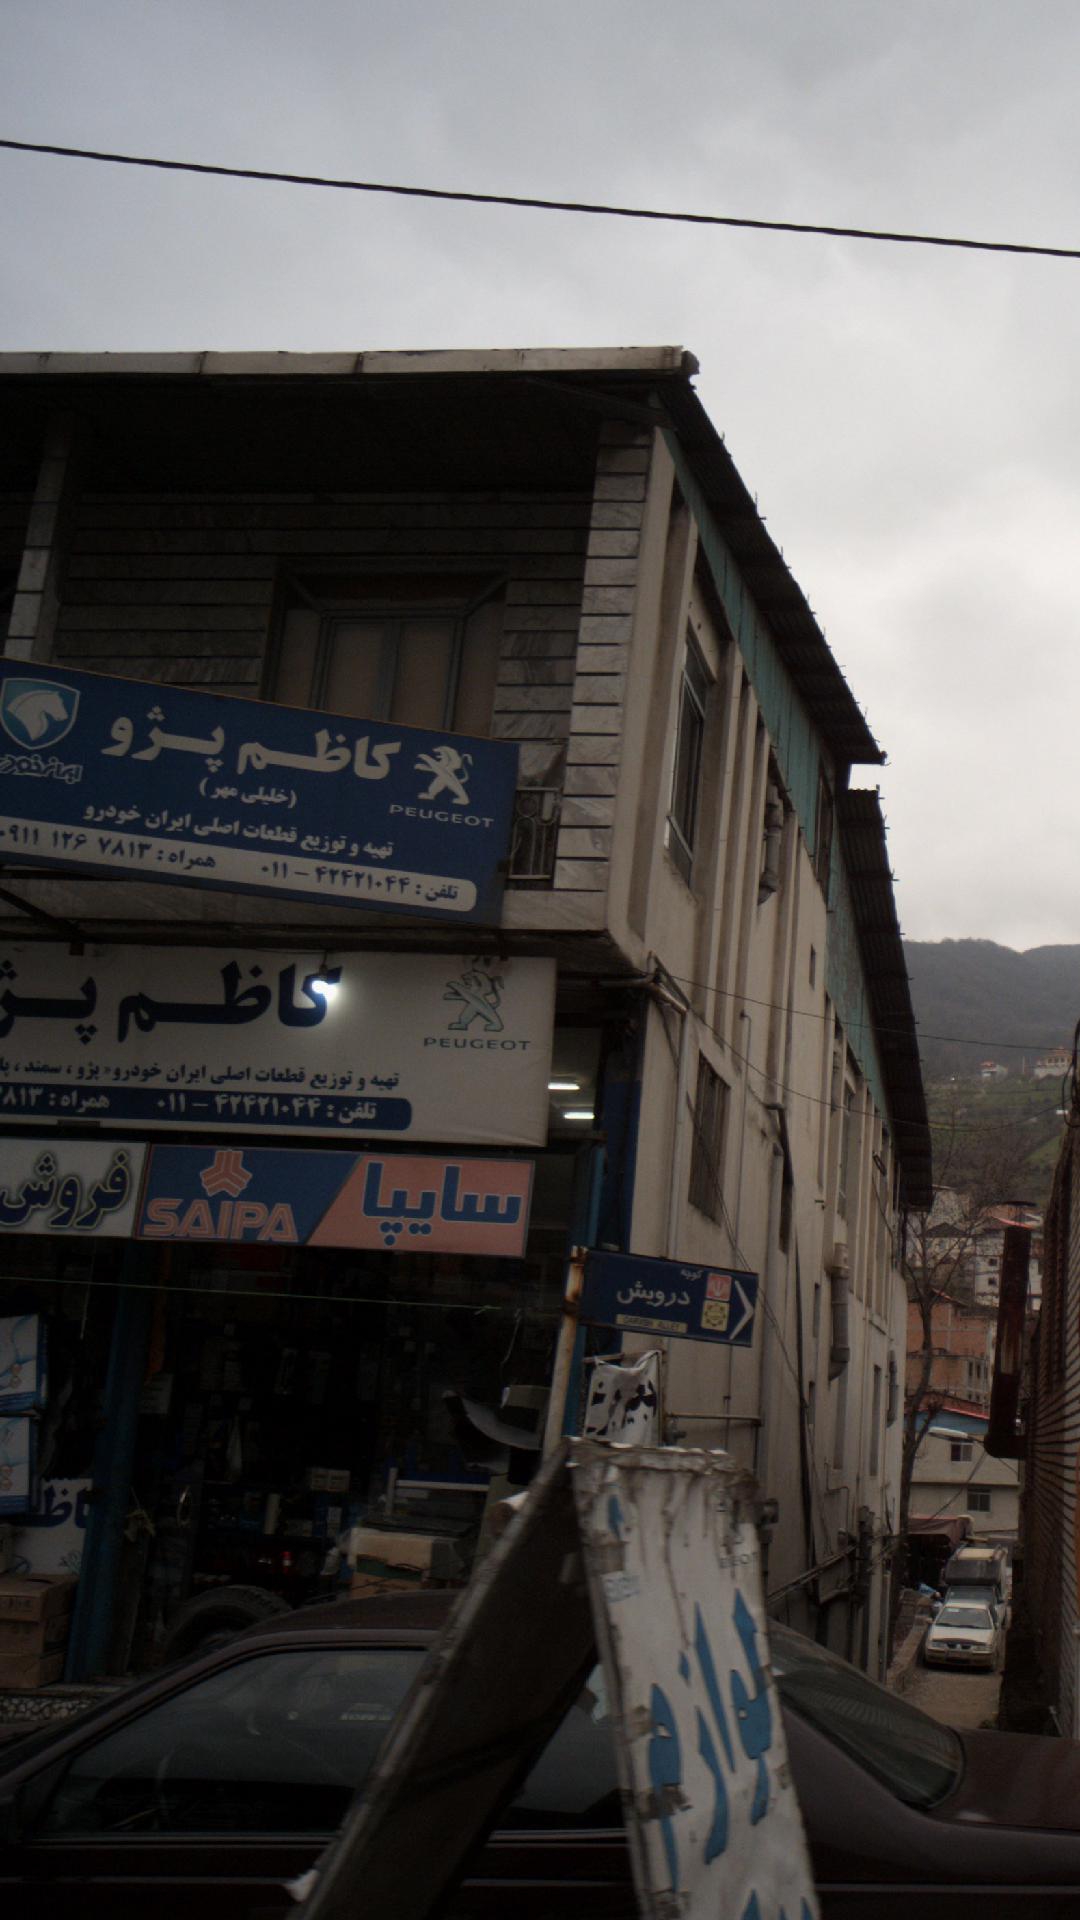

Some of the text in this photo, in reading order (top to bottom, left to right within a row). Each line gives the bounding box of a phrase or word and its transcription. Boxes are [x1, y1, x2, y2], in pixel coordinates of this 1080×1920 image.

[101, 705, 402, 780] کاظم پژو
[389, 803, 494, 829] PEUGEOT
[82, 804, 395, 860] تهیه و توزیع قطعات اصلی ایران خودرو
[118, 960, 343, 1043] کاظم
[423, 1036, 532, 1051] PEUGEOT
[165, 1064, 207, 1084] ایران
[210, 1065, 250, 1085] اصلی
[254, 1066, 306, 1084] قطعات
[309, 1071, 353, 1090] توزیع
[357, 1077, 366, 1091] و
[370, 1072, 400, 1091] تهیه
[0, 1085, 43, 1107] ۸۱۳
[0, 1150, 131, 1230] فروش
[363, 1161, 521, 1246] سایپا
[143, 1198, 300, 1244] SAIPA
[616, 1280, 691, 1308] درویش
